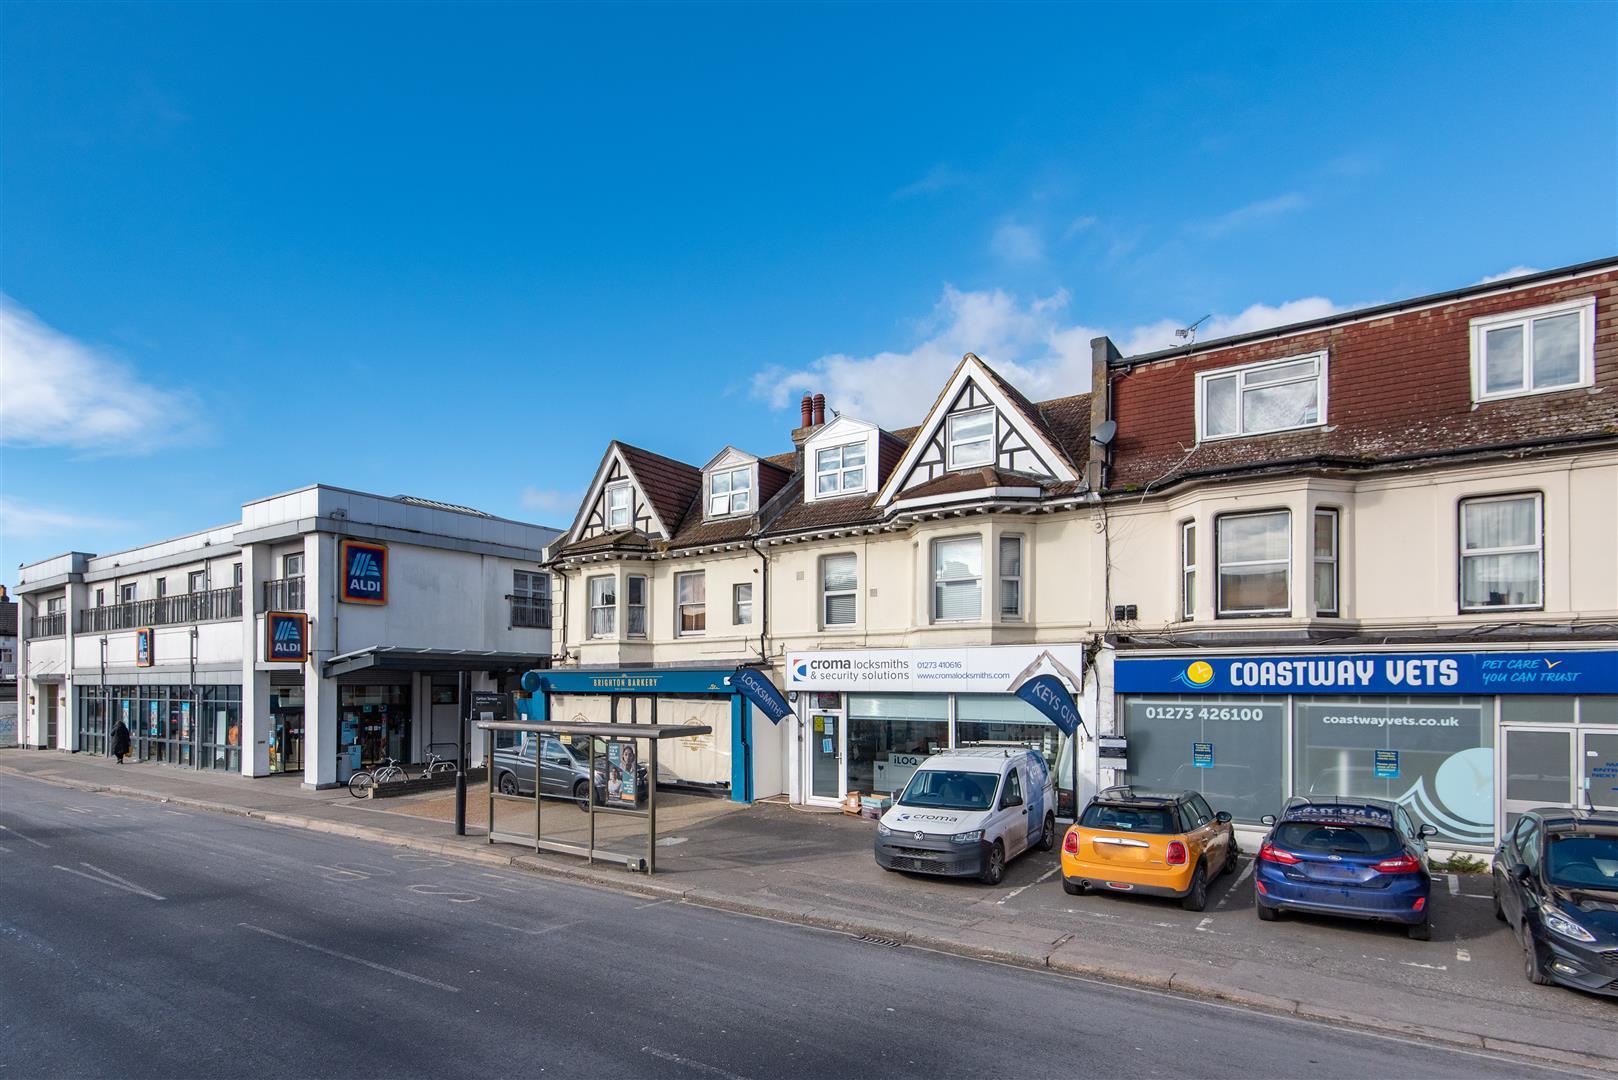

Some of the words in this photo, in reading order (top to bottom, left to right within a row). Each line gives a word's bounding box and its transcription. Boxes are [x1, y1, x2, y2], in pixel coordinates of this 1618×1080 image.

[350, 579, 380, 592] ALDI
[275, 643, 300, 652] ALDI
[810, 660, 851, 669] croma
[853, 658, 909, 669] locksmiths
[916, 661, 937, 669] 01273
[939, 661, 962, 669] 410616
[1482, 660, 1506, 669] PET
[1506, 659, 1541, 669] CARE
[810, 671, 817, 680] &
[820, 670, 859, 682] security
[862, 671, 910, 680] solutions
[916, 671, 1010, 680] www.cromalocksmiths.com
[1230, 660, 1374, 687] COASTWAY
[1385, 659, 1458, 686] VETS
[1482, 672, 1507, 685] YOU
[1510, 672, 1537, 682] CAN
[1540, 672, 1582, 682] TRUST
[593, 678, 625, 687] BRIGHTON
[628, 678, 658, 687] BARKERY
[741, 673, 784, 717] LOCKSMITHS
[1032, 681, 1061, 711] KEYS
[1060, 705, 1077, 728] CUT
[1145, 707, 1194, 720] 01273
[1198, 708, 1264, 721] 426100
[1322, 714, 1460, 727] coastwayvets.co.uk
[894, 755, 918, 766] iLOQ
[913, 813, 958, 823] croma
